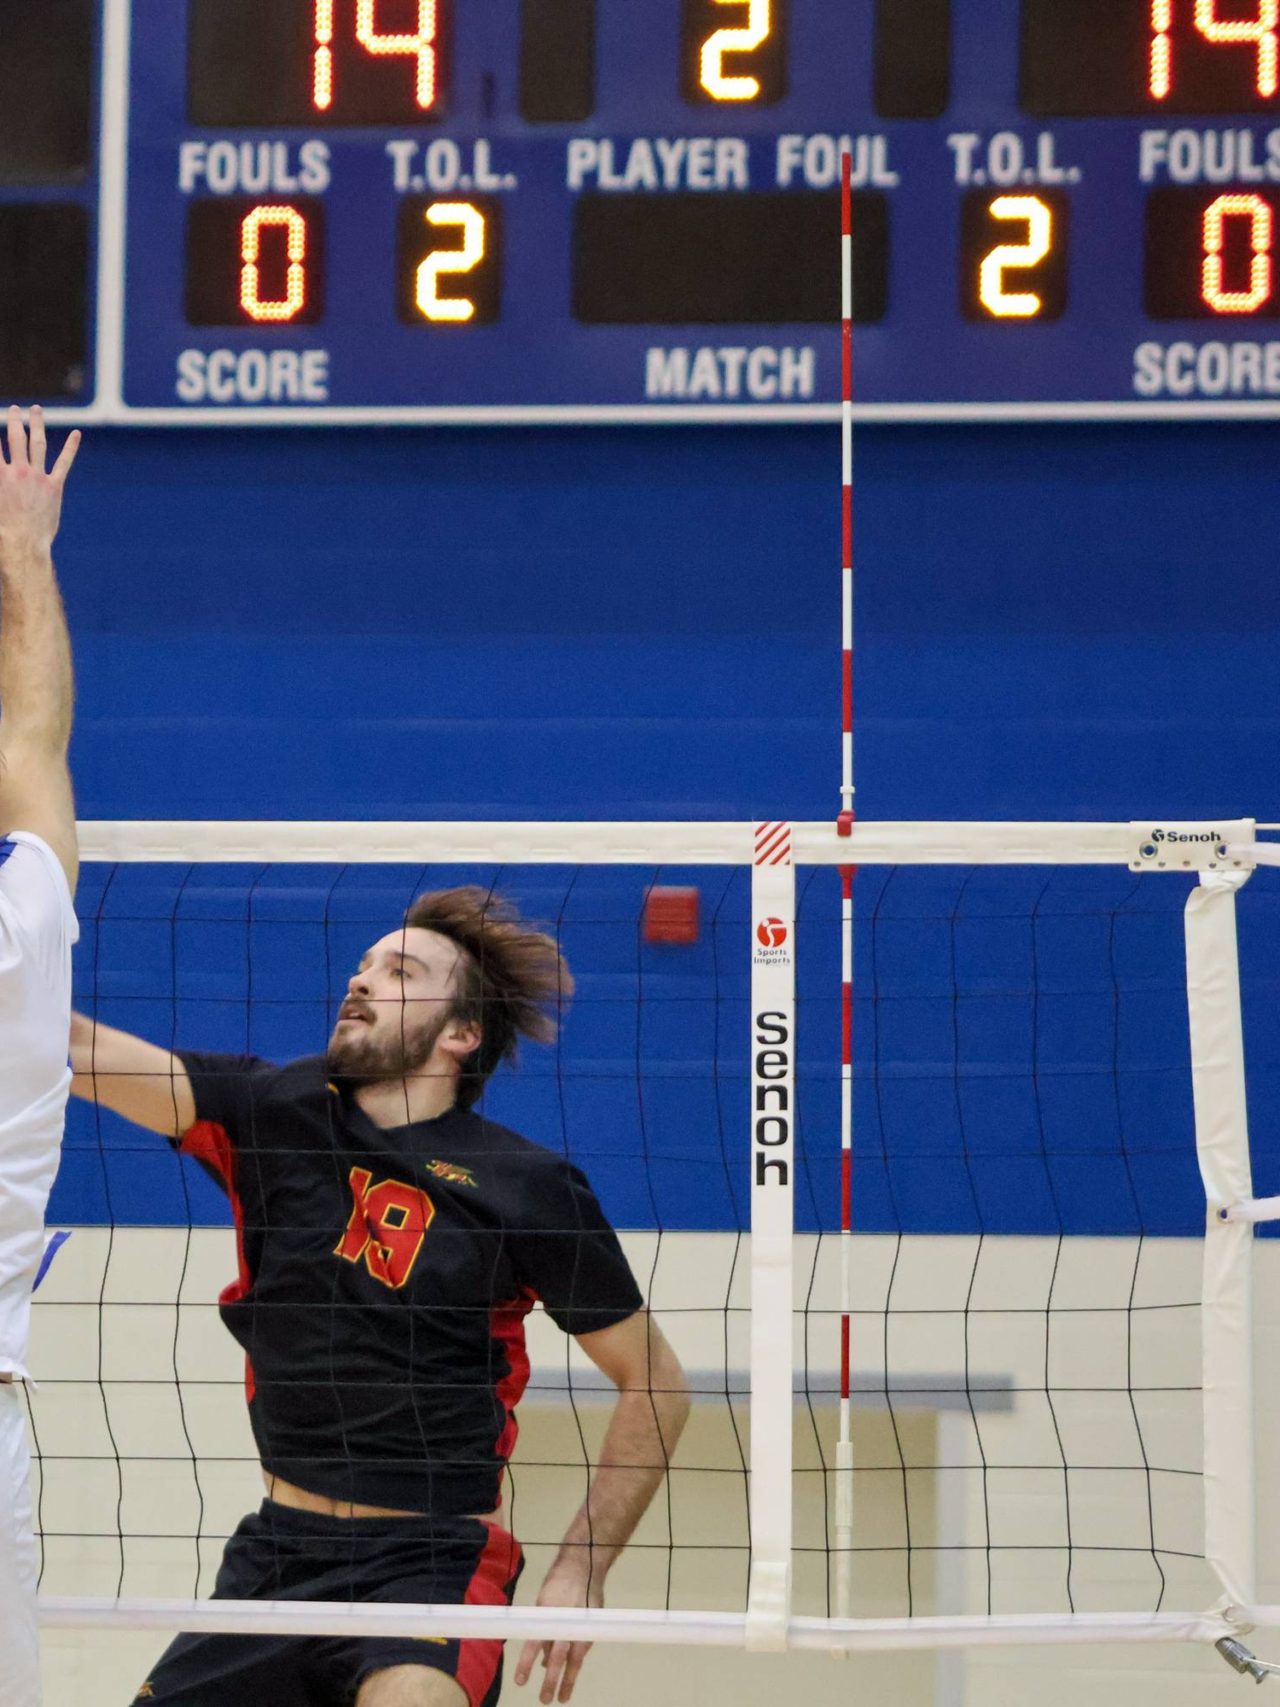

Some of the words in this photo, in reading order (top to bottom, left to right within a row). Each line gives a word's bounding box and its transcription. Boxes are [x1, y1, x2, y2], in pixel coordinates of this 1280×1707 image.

[314, 0, 436, 109] 14
[700, 0, 770, 100] 2
[1149, 0, 1279, 99] 14
[178, 140, 331, 193] FOULS
[386, 139, 517, 191] T.O.L.
[566, 138, 750, 190] PLAYER
[776, 134, 900, 187] FOUL
[948, 132, 1081, 184] T.O.L.
[240, 205, 306, 322] 0
[415, 203, 485, 322] 2
[980, 195, 1052, 316] 2
[1201, 194, 1272, 313] 0
[175, 349, 329, 402] SCORE
[645, 346, 816, 398] MATCH
[1167, 831, 1221, 842] Senoh
[753, 956, 791, 965] Imports
[758, 948, 787, 957] Sports
[755, 1010, 789, 1186] Senoh
[332, 1165, 436, 1291] 19
